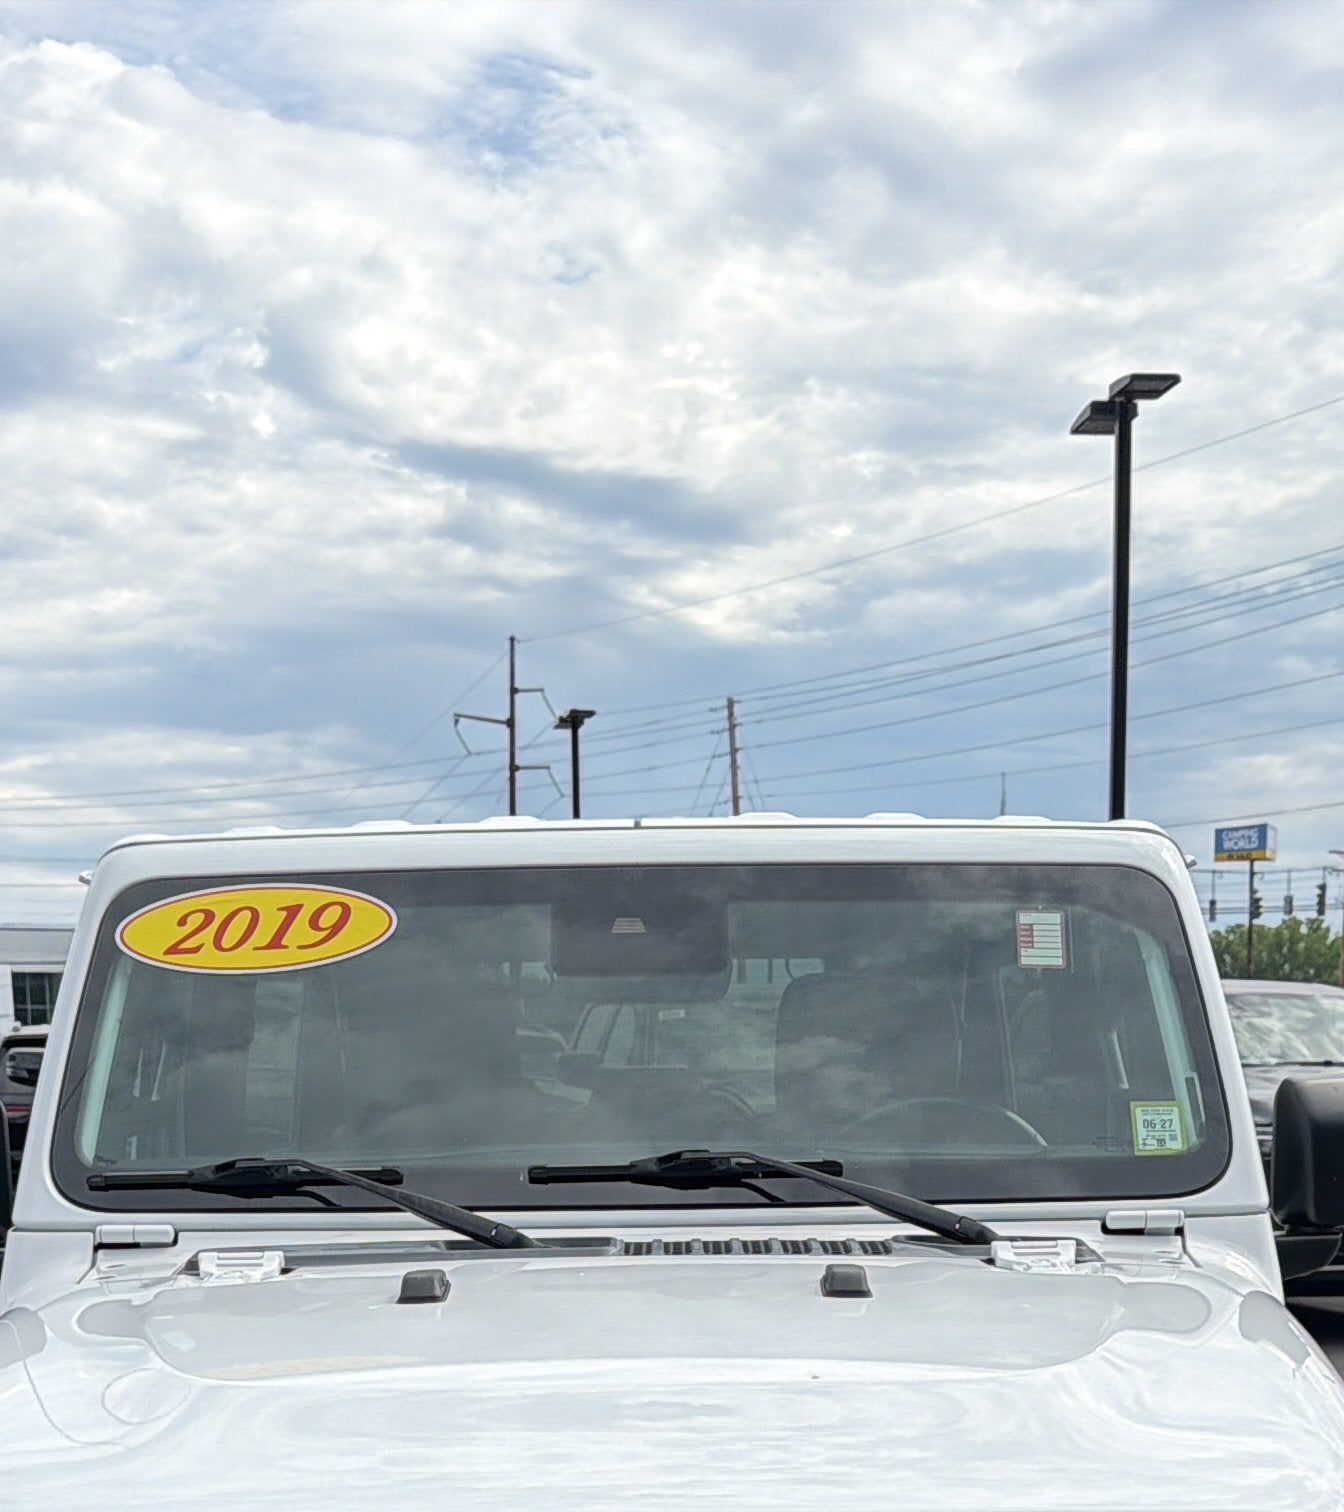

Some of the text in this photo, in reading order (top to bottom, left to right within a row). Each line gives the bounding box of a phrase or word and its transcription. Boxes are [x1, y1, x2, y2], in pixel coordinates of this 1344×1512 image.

[1222, 828, 1259, 840] CAMPING
[1223, 837, 1259, 850] WORLD
[163, 901, 352, 956] 2019
